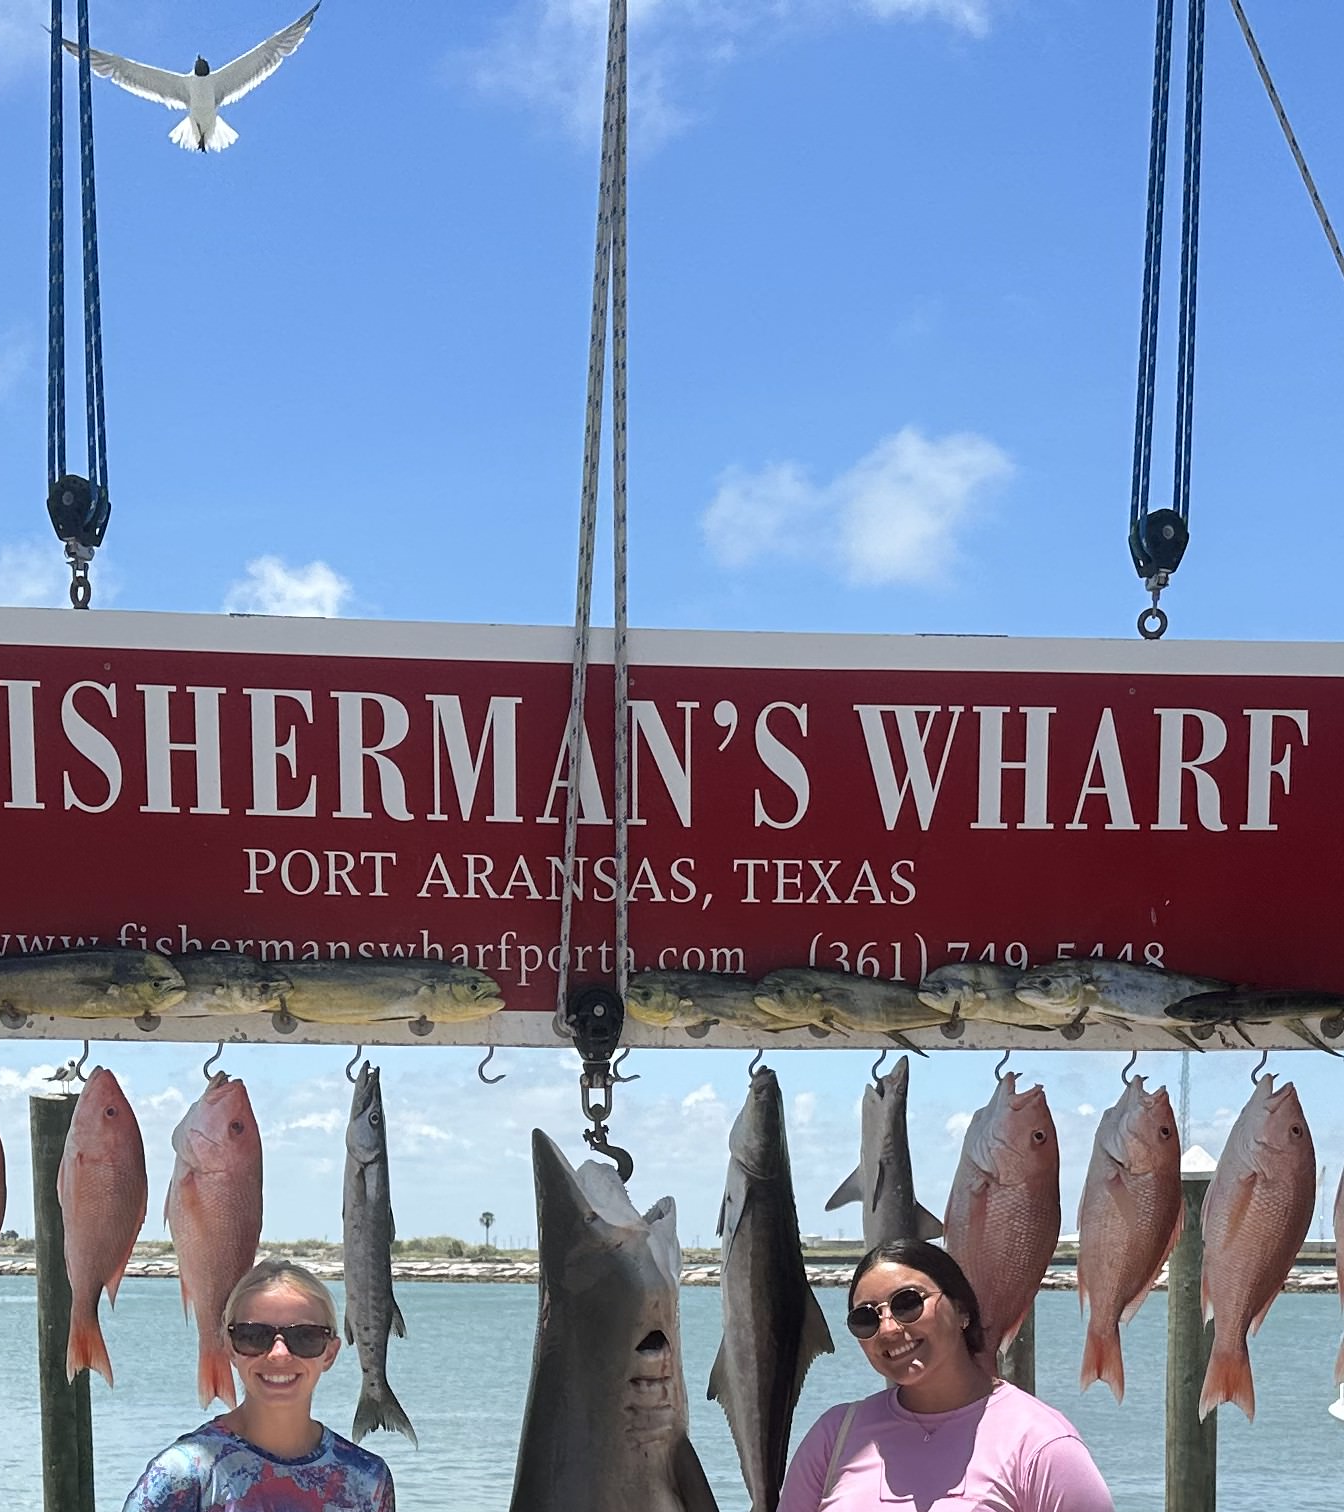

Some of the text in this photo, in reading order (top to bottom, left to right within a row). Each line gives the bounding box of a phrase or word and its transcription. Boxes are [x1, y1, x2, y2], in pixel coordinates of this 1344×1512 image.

[853, 703, 1310, 831] WHARF
[243, 848, 916, 910] PORT ARANSAS, TEXAS
[809, 931, 928, 986] (361)
